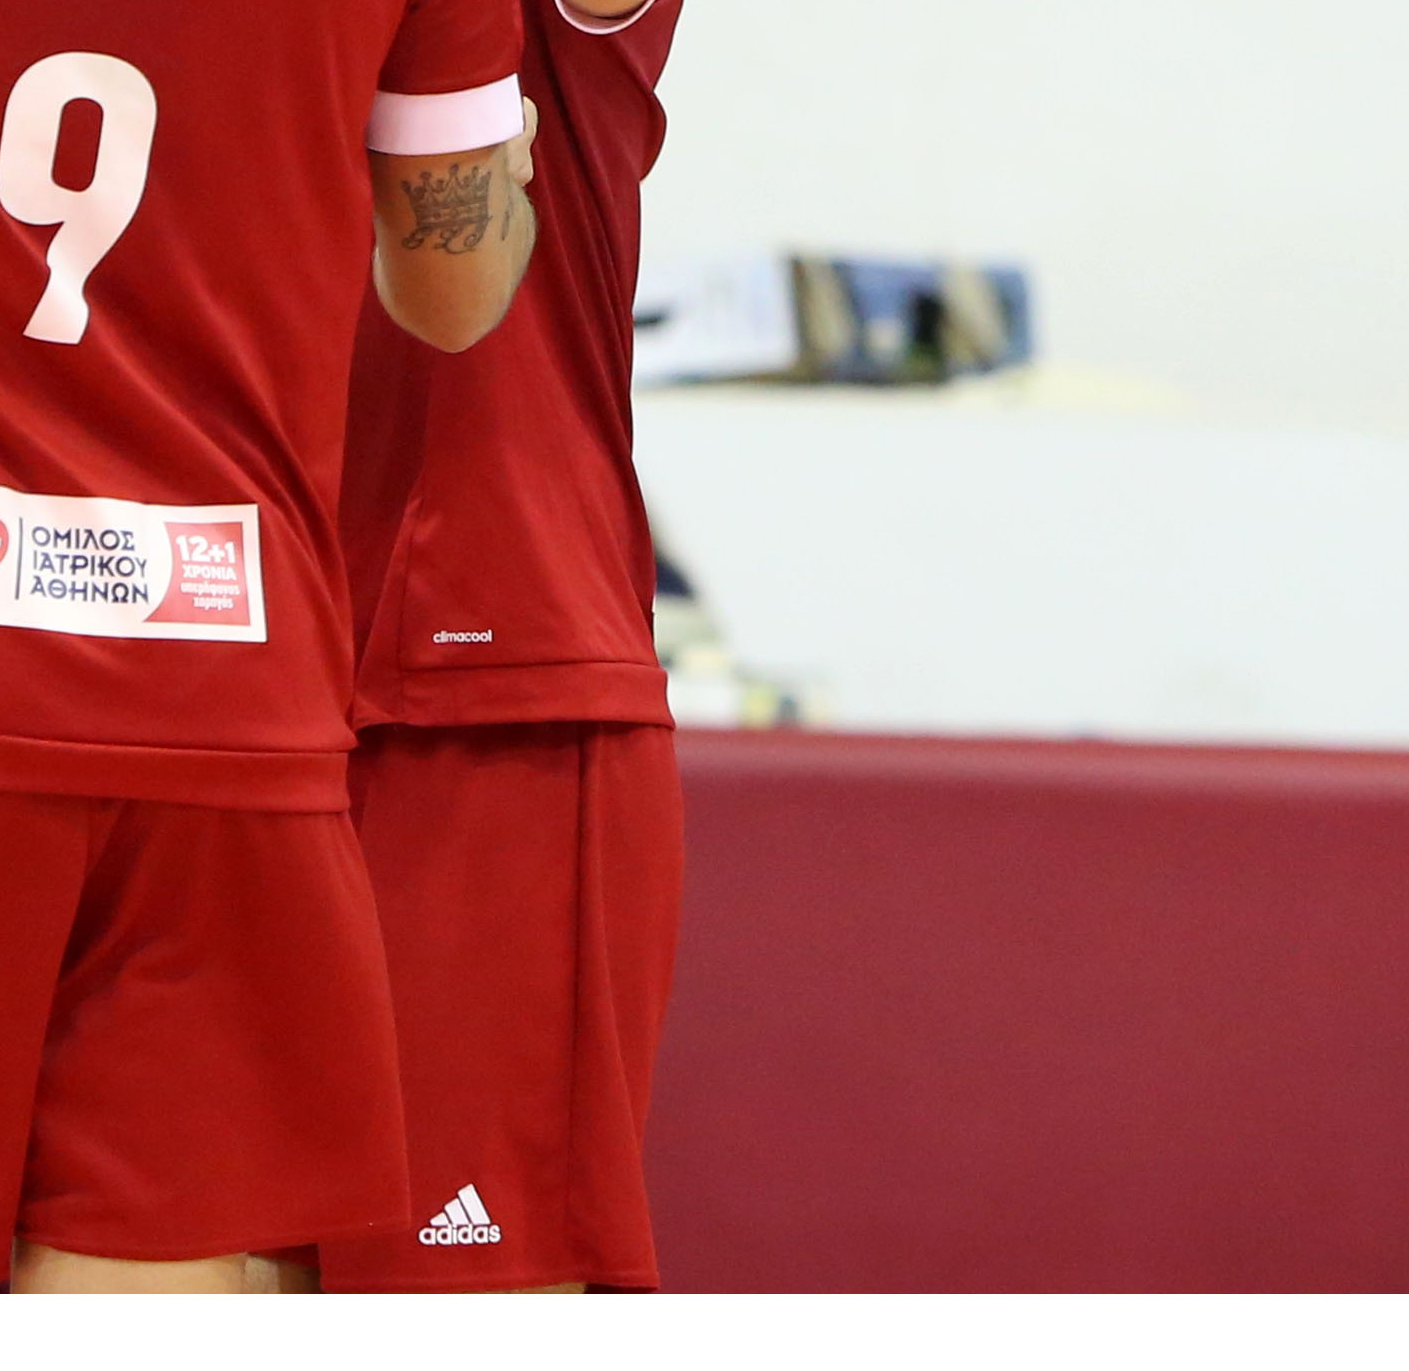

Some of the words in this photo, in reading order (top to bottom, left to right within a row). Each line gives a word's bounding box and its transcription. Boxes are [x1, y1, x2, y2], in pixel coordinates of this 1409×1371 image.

[31, 526, 135, 551] ΟΜΙΛΟΣ
[176, 535, 236, 565] 12+1
[32, 550, 147, 578] ΙΑΤΡΙΚΟΥ
[182, 564, 237, 580] ΧΡΟΝΙΑ
[30, 575, 148, 604] ΑΘΗΝΩΝ
[419, 1224, 502, 1245] adidas
